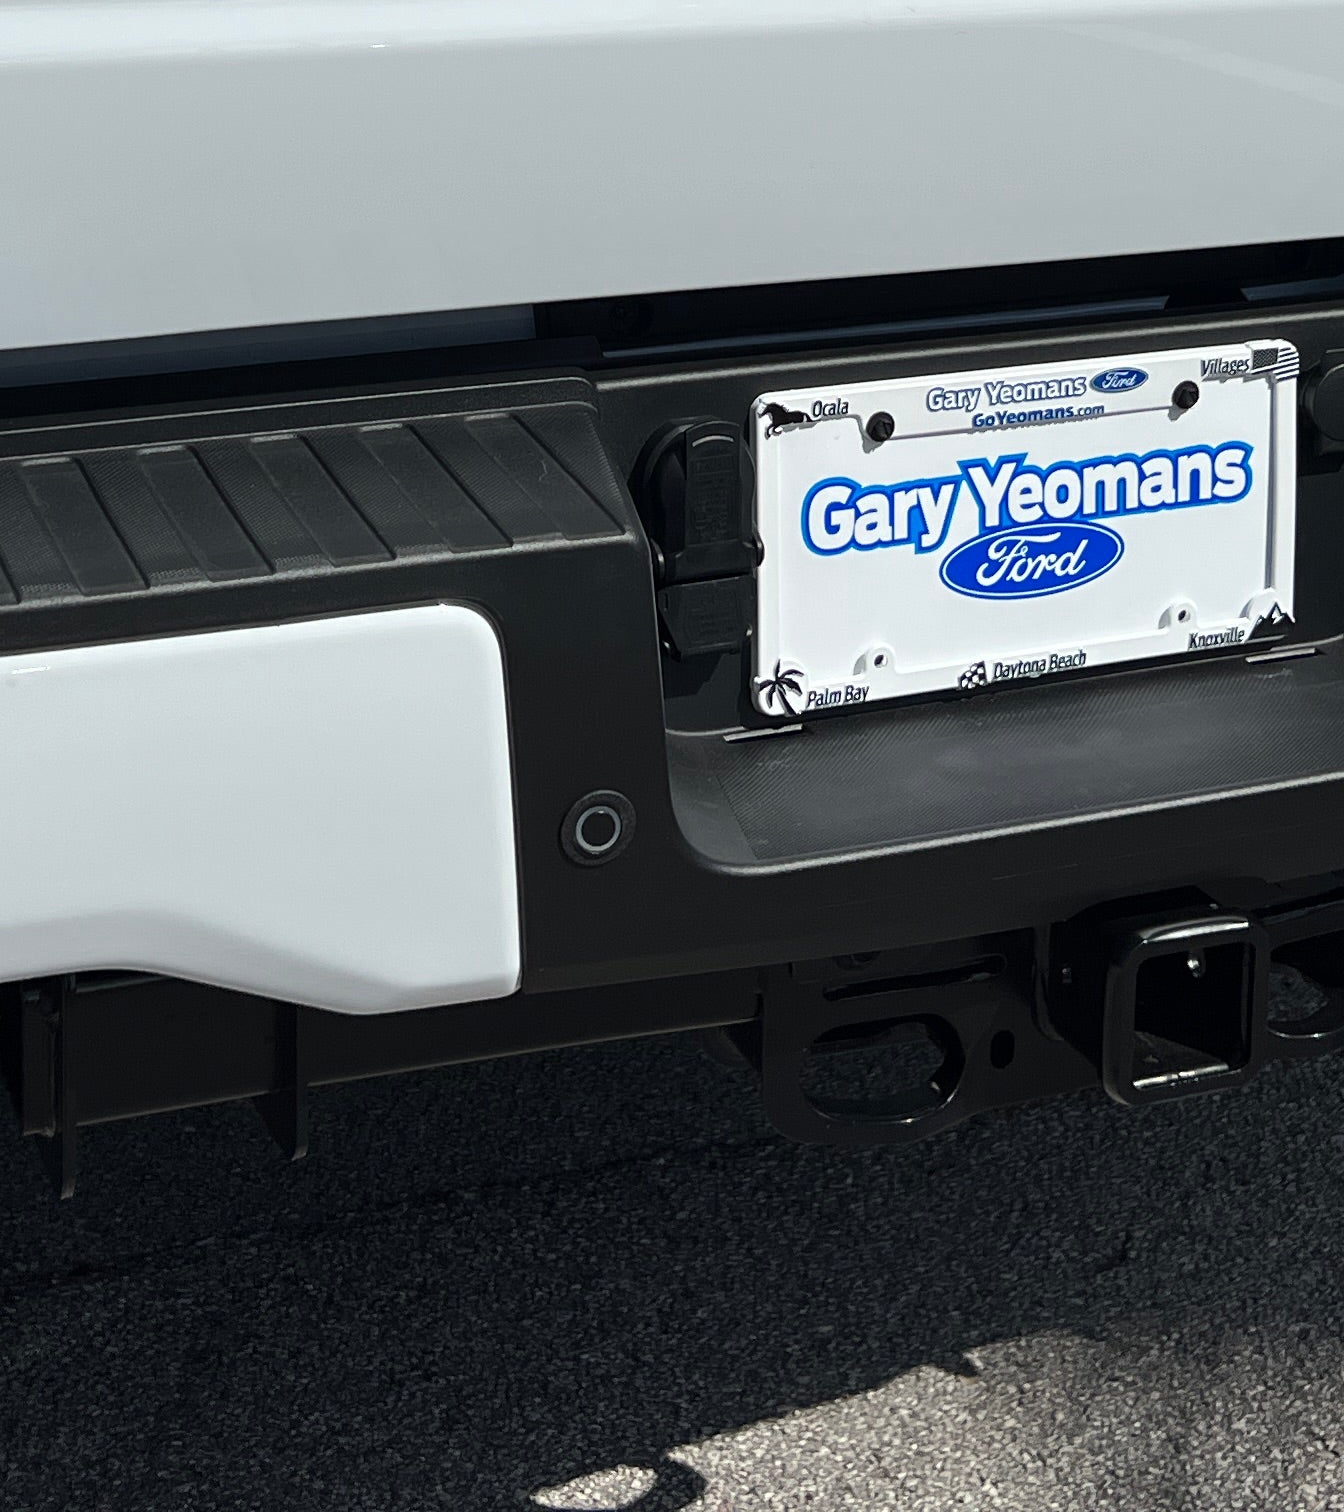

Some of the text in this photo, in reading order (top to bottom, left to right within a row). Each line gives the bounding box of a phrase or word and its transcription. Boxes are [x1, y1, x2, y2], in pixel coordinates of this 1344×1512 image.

[1201, 358, 1250, 376] Villages
[1101, 370, 1138, 389] Ford
[927, 376, 1087, 412] Gary Yeomans
[812, 398, 849, 417] Ocala
[972, 404, 1105, 428] GoYeomans.com
[802, 477, 957, 555] Gary
[958, 441, 1254, 528] Yeomans
[975, 530, 1088, 588] Ford
[1188, 627, 1245, 648] Knoxville
[994, 648, 1087, 679] Daytona Beach
[806, 684, 869, 708] Palm Bay
